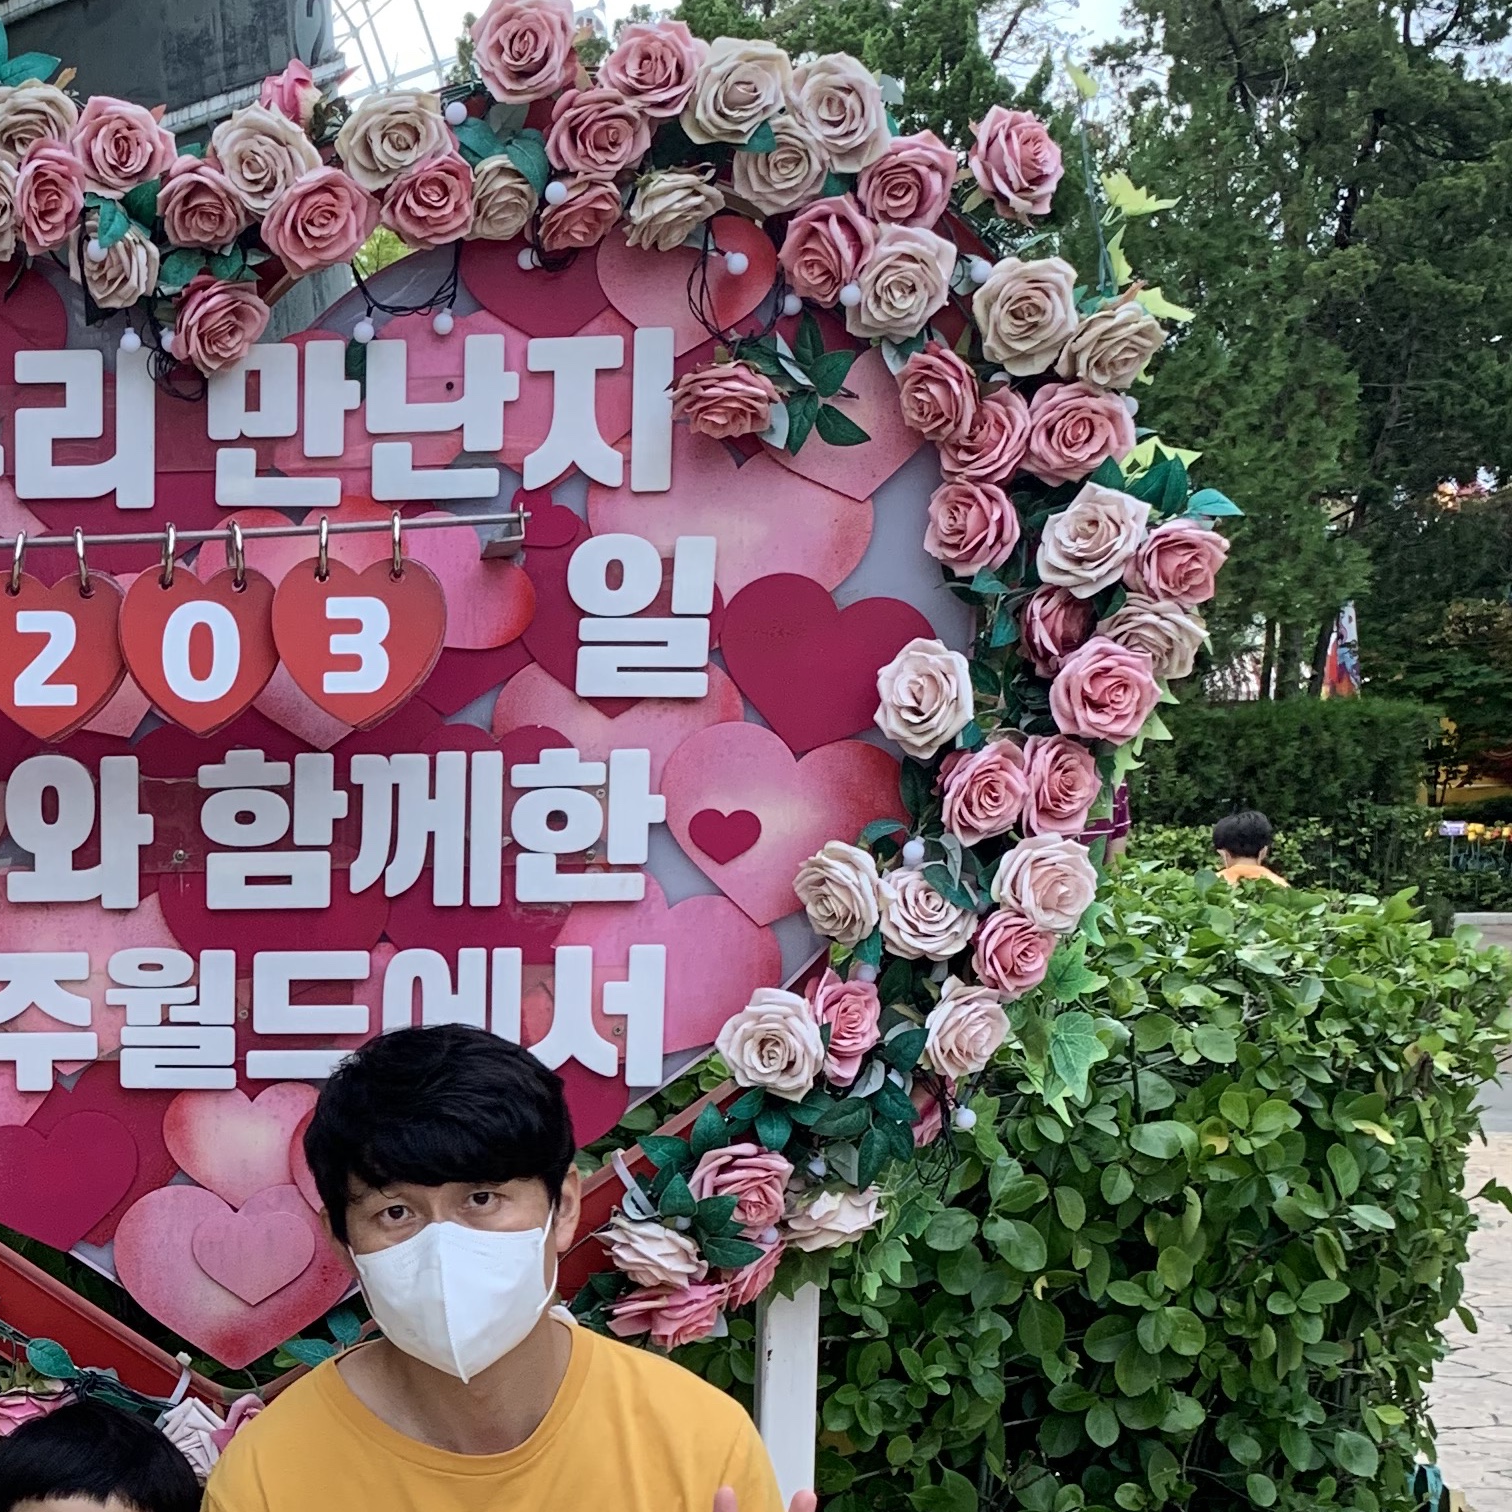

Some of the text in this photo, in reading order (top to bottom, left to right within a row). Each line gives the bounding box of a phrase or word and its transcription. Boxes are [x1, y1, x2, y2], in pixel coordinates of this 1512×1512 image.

[207, 326, 673, 508] 만난지
[566, 533, 717, 698] 일
[199, 747, 667, 909] 함께한
